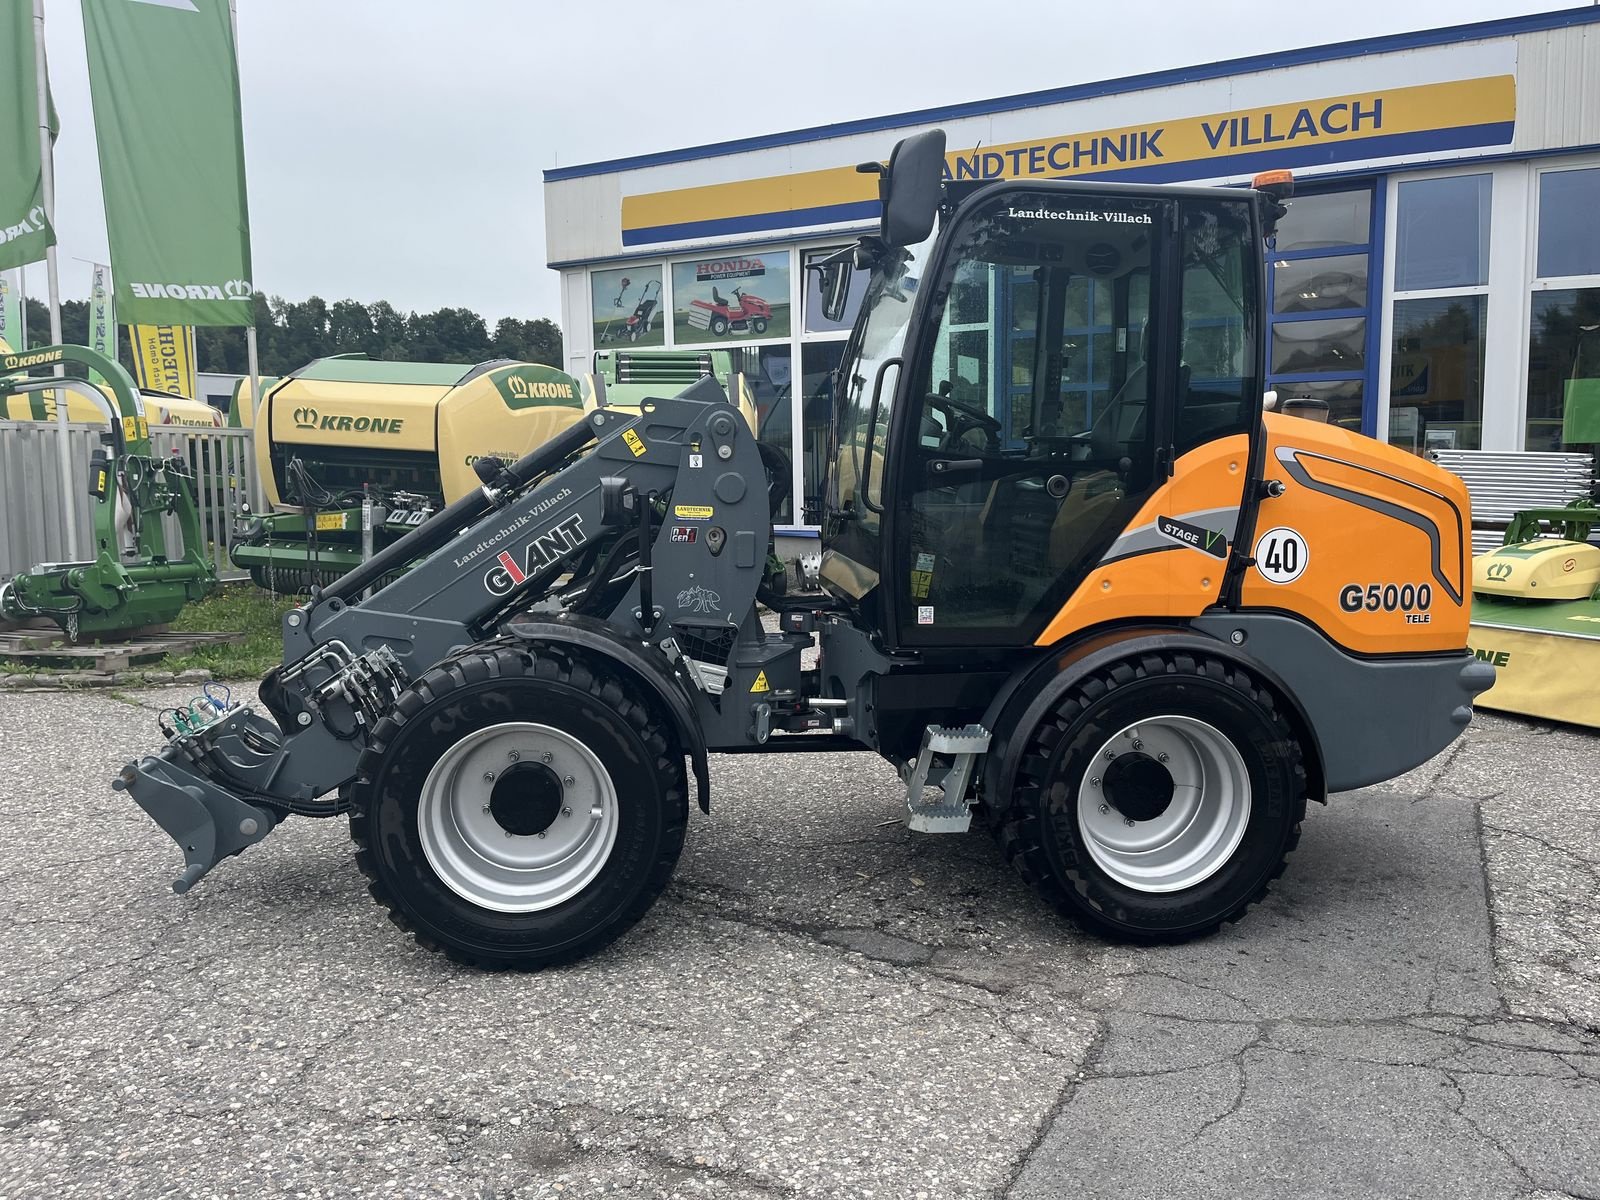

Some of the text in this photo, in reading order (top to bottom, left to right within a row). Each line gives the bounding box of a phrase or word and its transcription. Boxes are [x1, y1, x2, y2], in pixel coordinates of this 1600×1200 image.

[1201, 98, 1382, 151] VILLACH
[1008, 207, 1152, 224] Landtechnik-Villach
[697, 256, 766, 275] HONDA
[711, 270, 751, 280] POWER EQUIPMENT
[19, 350, 63, 367] KRONE
[528, 382, 573, 399] KRONE
[319, 415, 404, 434] KRONE
[453, 487, 572, 568] Landtechnik-Villach
[1164, 523, 1224, 549] STAGE V
[1265, 538, 1298, 573] 40
[1339, 583, 1431, 612] G5000
[1405, 614, 1430, 624] TELE
